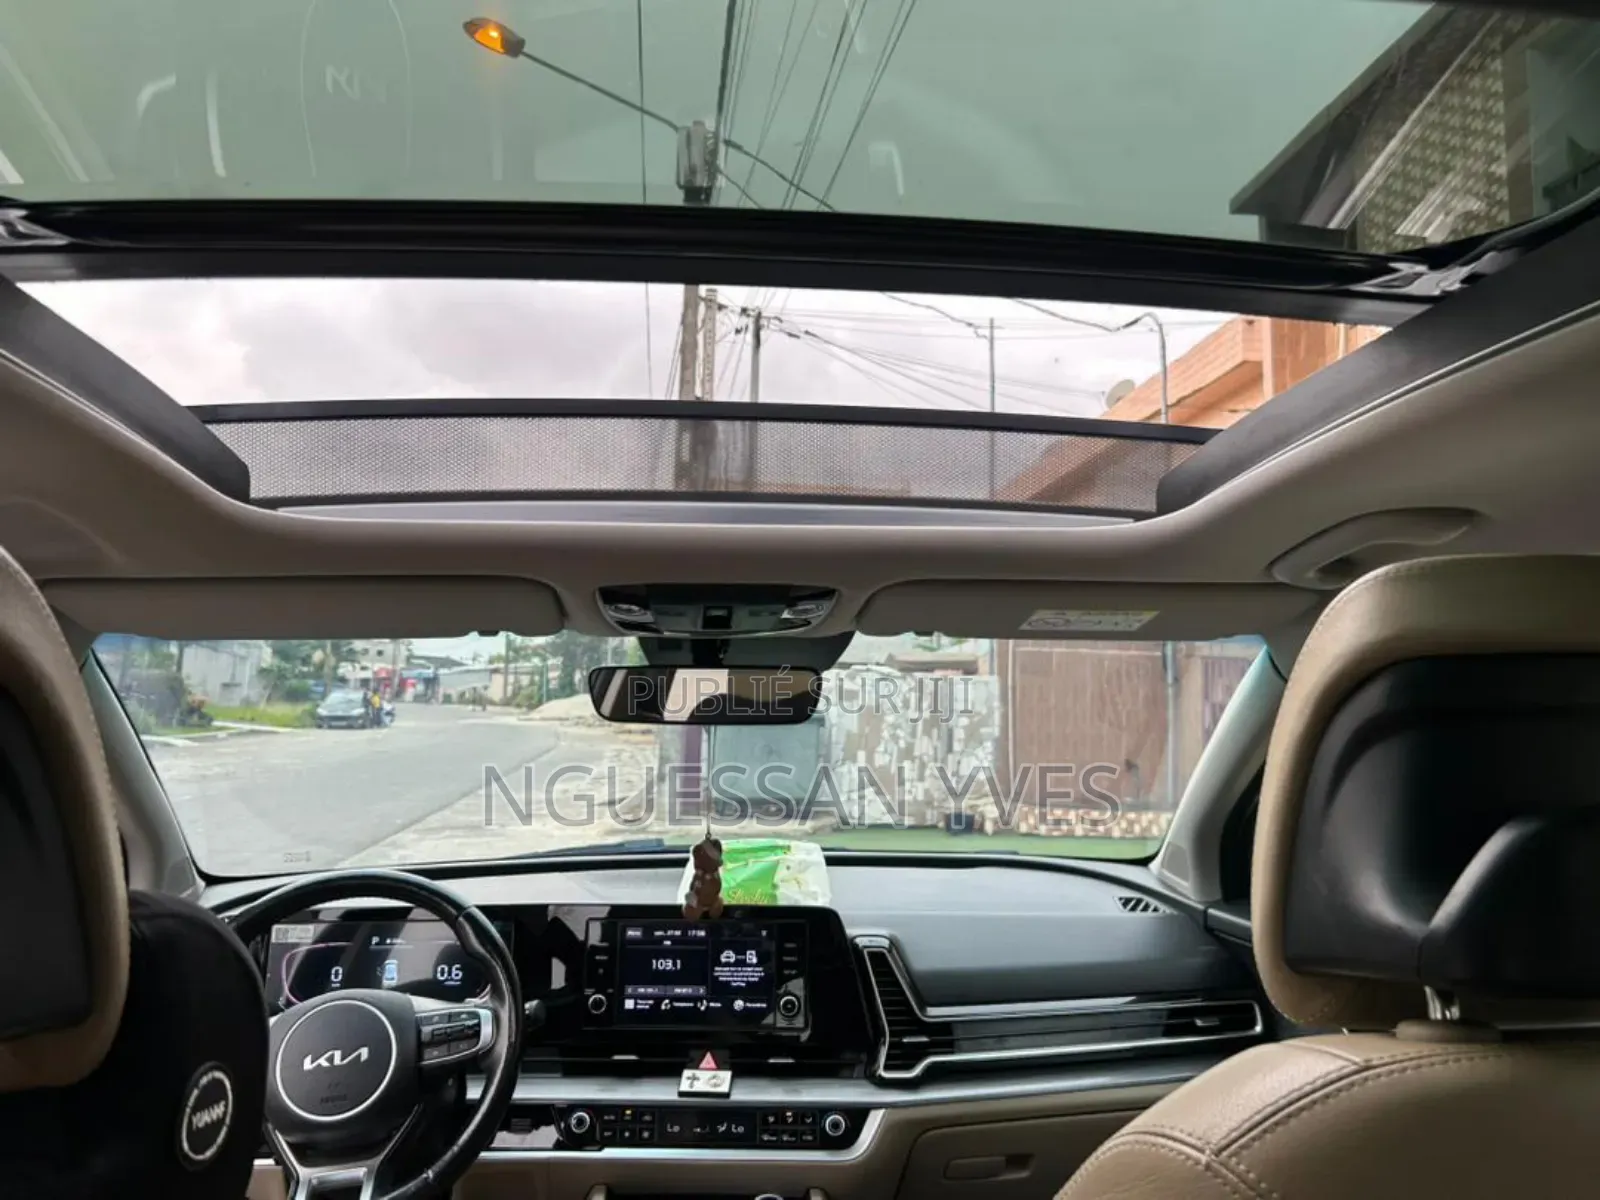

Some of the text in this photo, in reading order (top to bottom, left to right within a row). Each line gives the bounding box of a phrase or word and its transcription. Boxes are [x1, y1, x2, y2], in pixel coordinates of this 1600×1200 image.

[652, 959, 682, 970] 103.1
[331, 966, 343, 982] 0
[437, 964, 463, 980] 0.6
[666, 1123, 680, 1133] Lo
[731, 1123, 745, 1133] Lo
